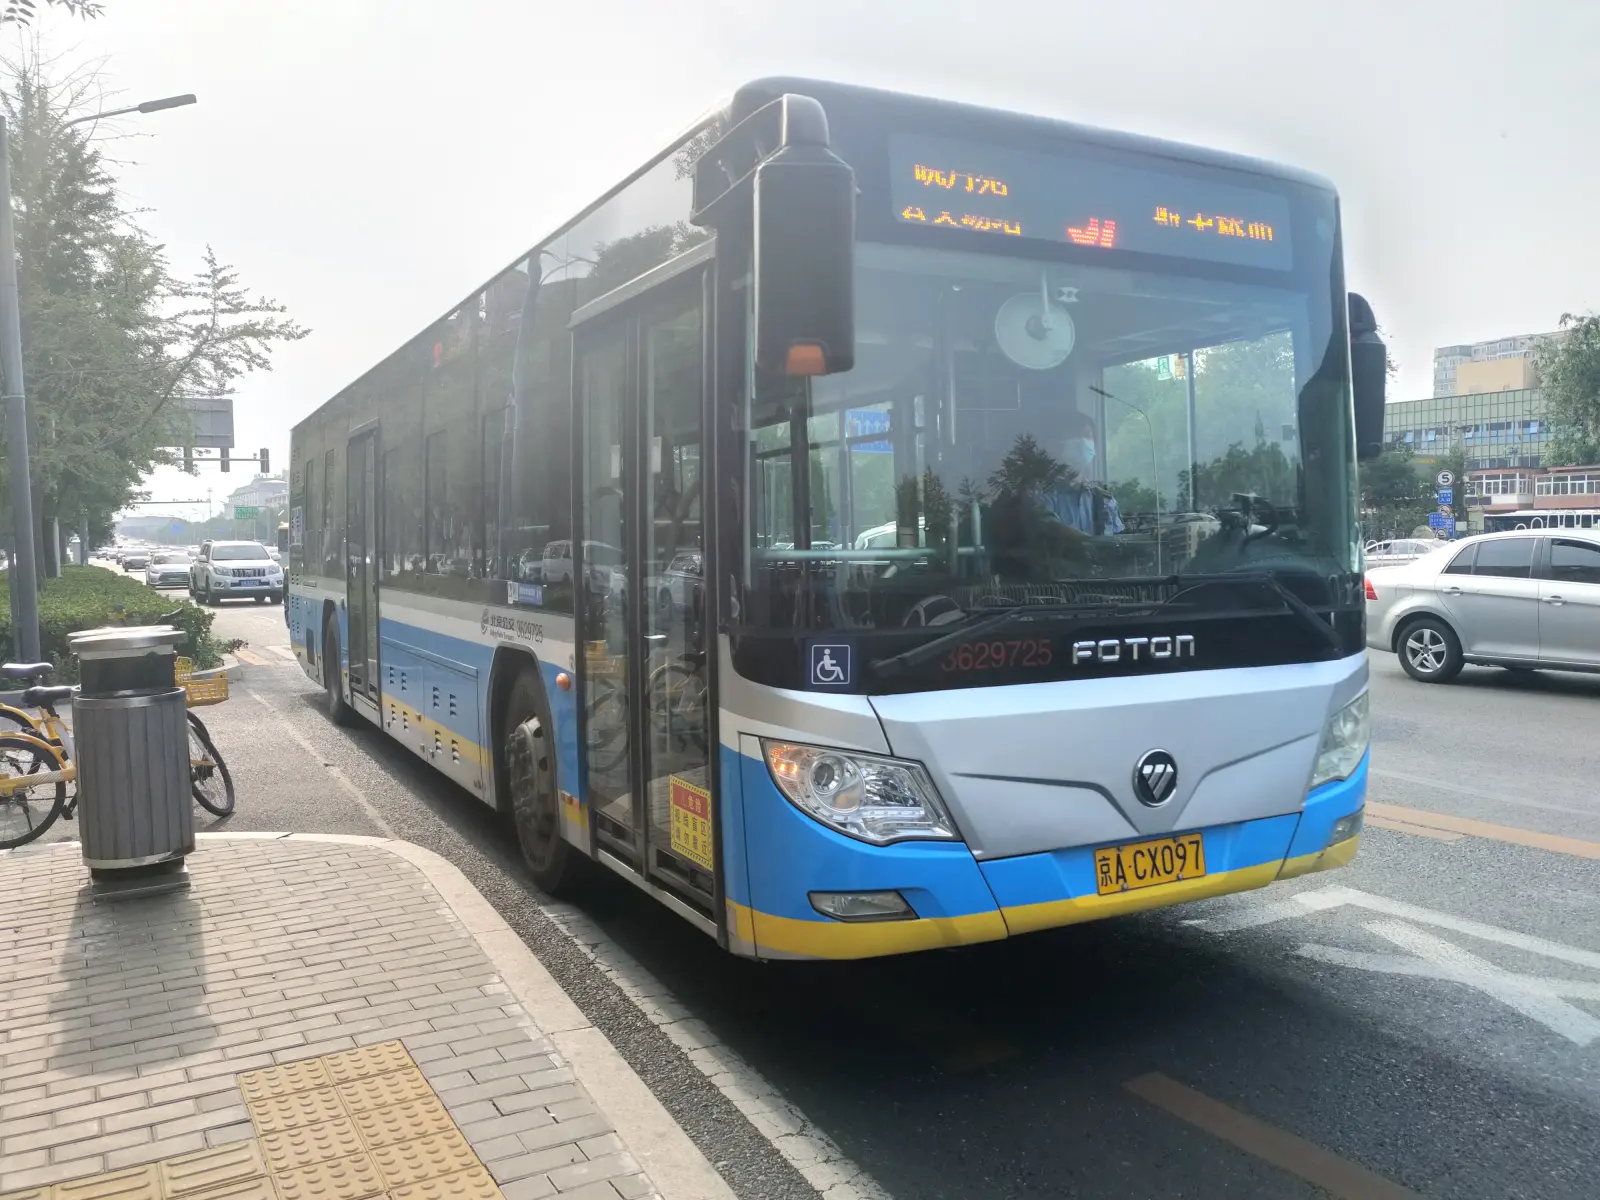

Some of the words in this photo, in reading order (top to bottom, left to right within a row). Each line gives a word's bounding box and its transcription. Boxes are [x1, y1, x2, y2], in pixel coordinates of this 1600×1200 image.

[1441, 474, 1450, 483] 5
[941, 639, 1053, 671] 3629725
[1073, 634, 1196, 665] FOTON
